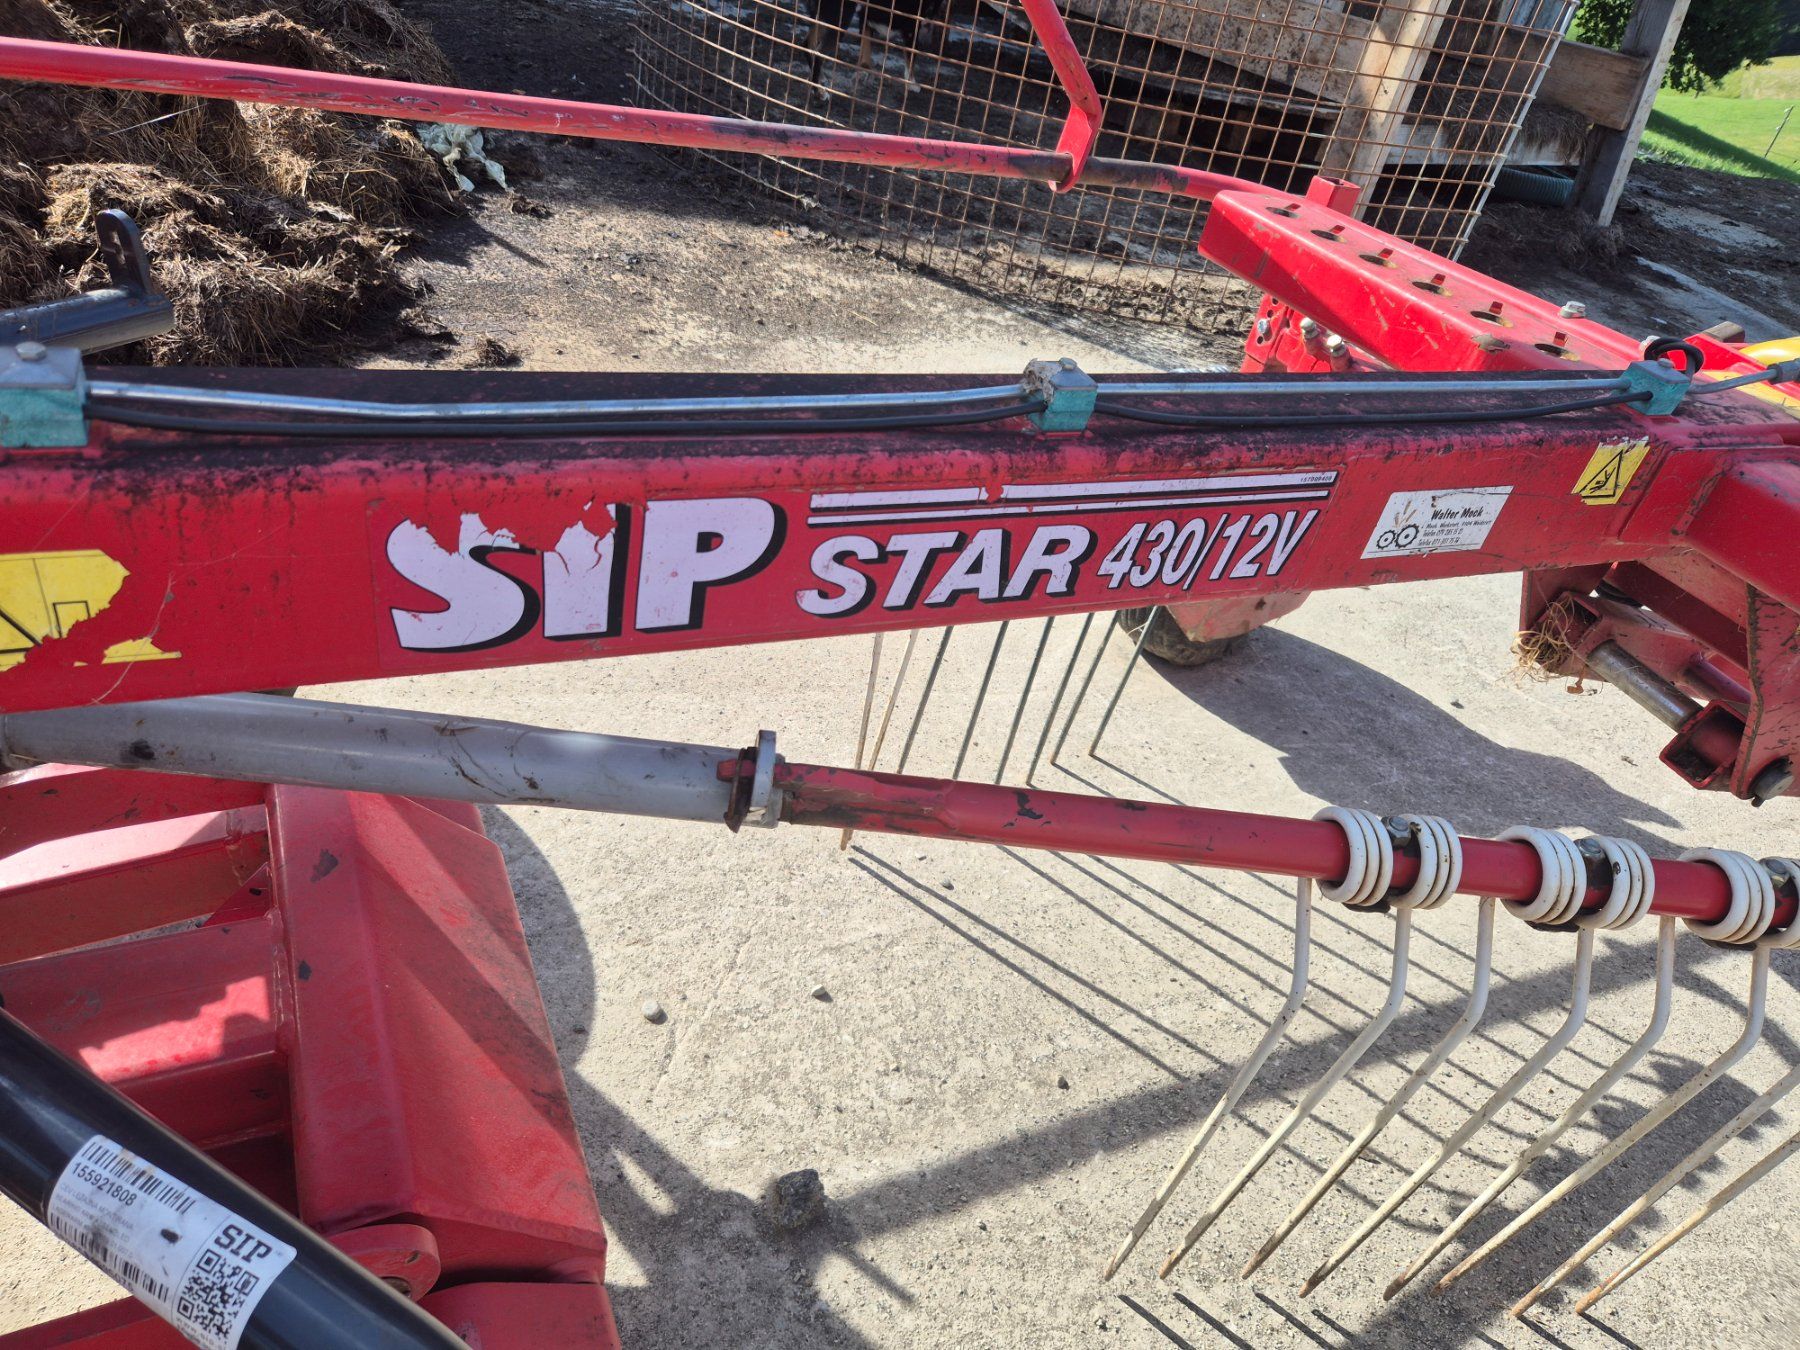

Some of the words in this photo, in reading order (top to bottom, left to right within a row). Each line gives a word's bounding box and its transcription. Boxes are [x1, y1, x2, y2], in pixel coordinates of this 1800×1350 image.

[1431, 508, 1459, 520] Walter
[386, 497, 787, 654] SIP
[796, 525, 1098, 618] STAR
[1097, 509, 1319, 591] 430/12V
[71, 1161, 138, 1206] 155921808
[213, 1223, 273, 1263] SIP
